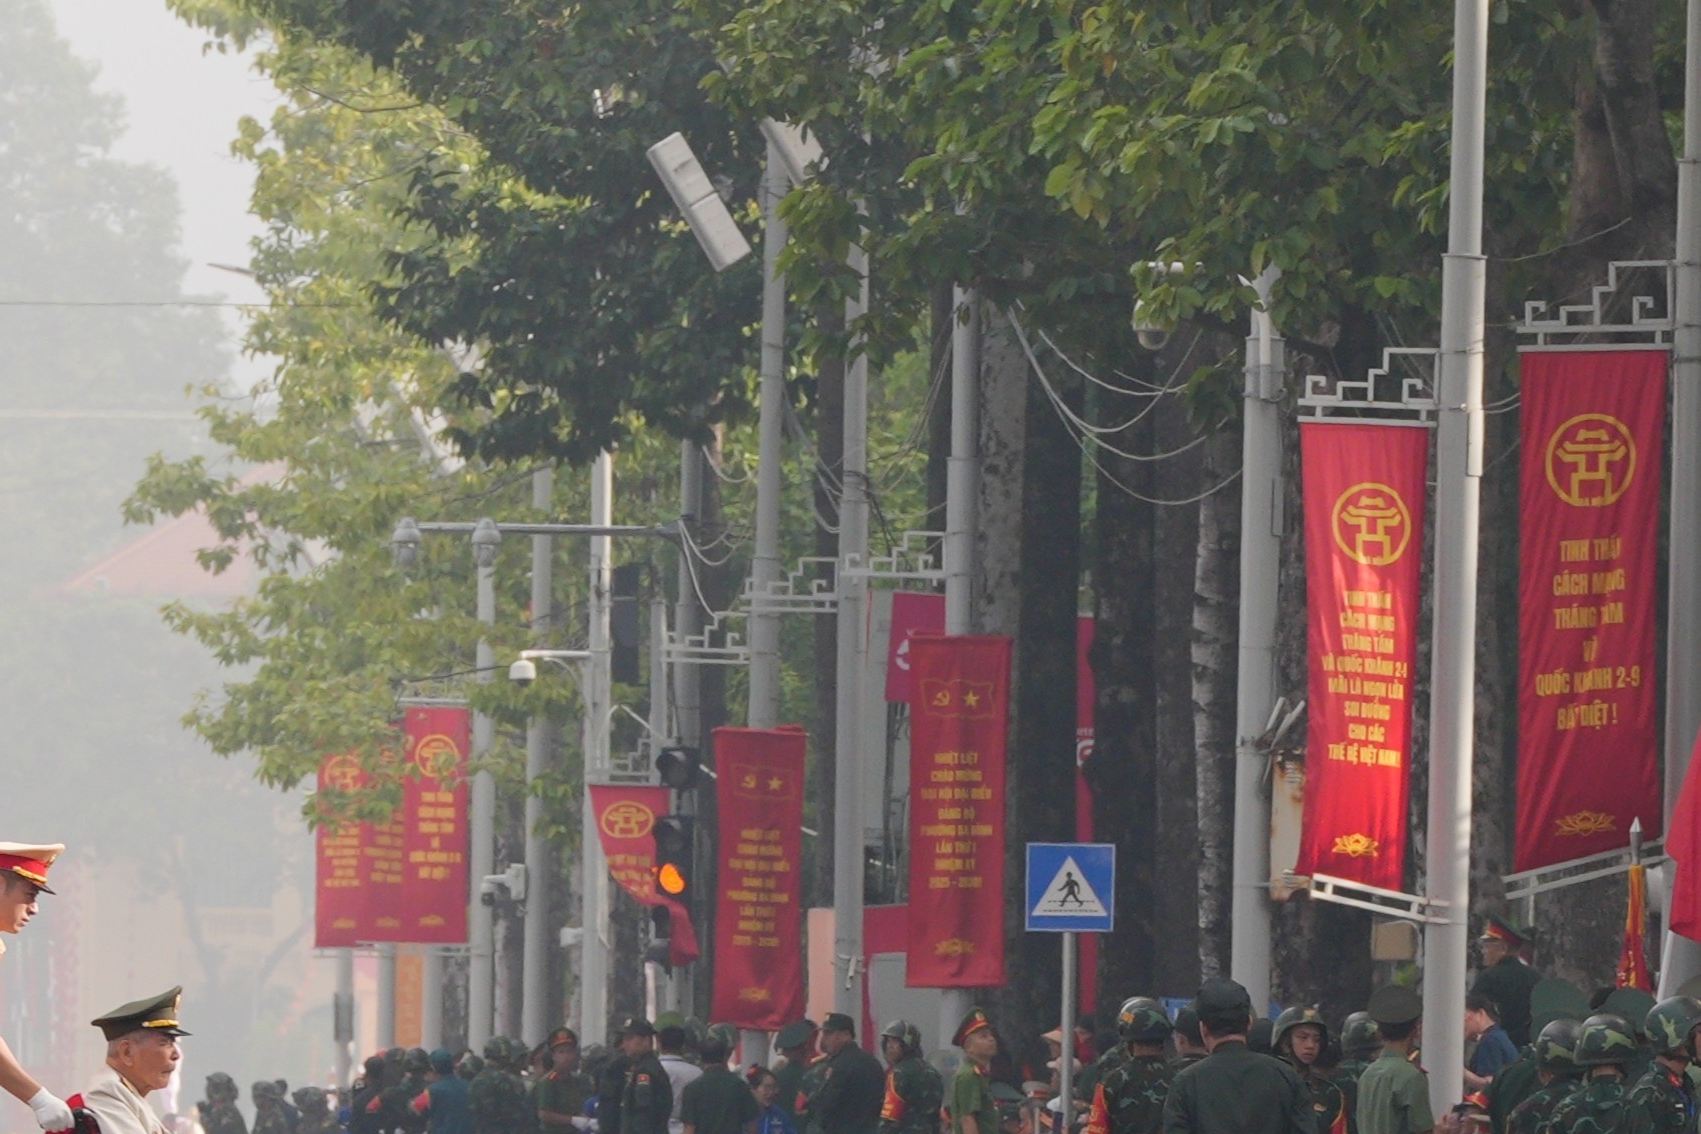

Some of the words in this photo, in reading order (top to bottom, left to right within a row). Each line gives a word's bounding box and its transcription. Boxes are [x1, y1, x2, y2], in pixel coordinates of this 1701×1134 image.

[1559, 539, 1589, 562] TINH
[1553, 569, 1588, 596] CÁCH
[1340, 609, 1366, 629] CÁCH
[1554, 603, 1596, 630] THÁNG
[1322, 652, 1335, 672] VÀ
[1336, 653, 1363, 673] QUỐC
[1363, 656, 1394, 677] KHÁNH
[1349, 677, 1362, 695] LÀ
[1535, 668, 1570, 697] QUỐC
[1616, 665, 1641, 689] 2-9
[1557, 703, 1579, 730] BẤ
[1580, 699, 1609, 730] DIỆT
[1348, 723, 1367, 740] CHO
[1367, 722, 1385, 742] CÁC
[1328, 741, 1347, 761] THẾ
[1346, 742, 1359, 766] HỆ
[1359, 744, 1377, 767] VIỆT
